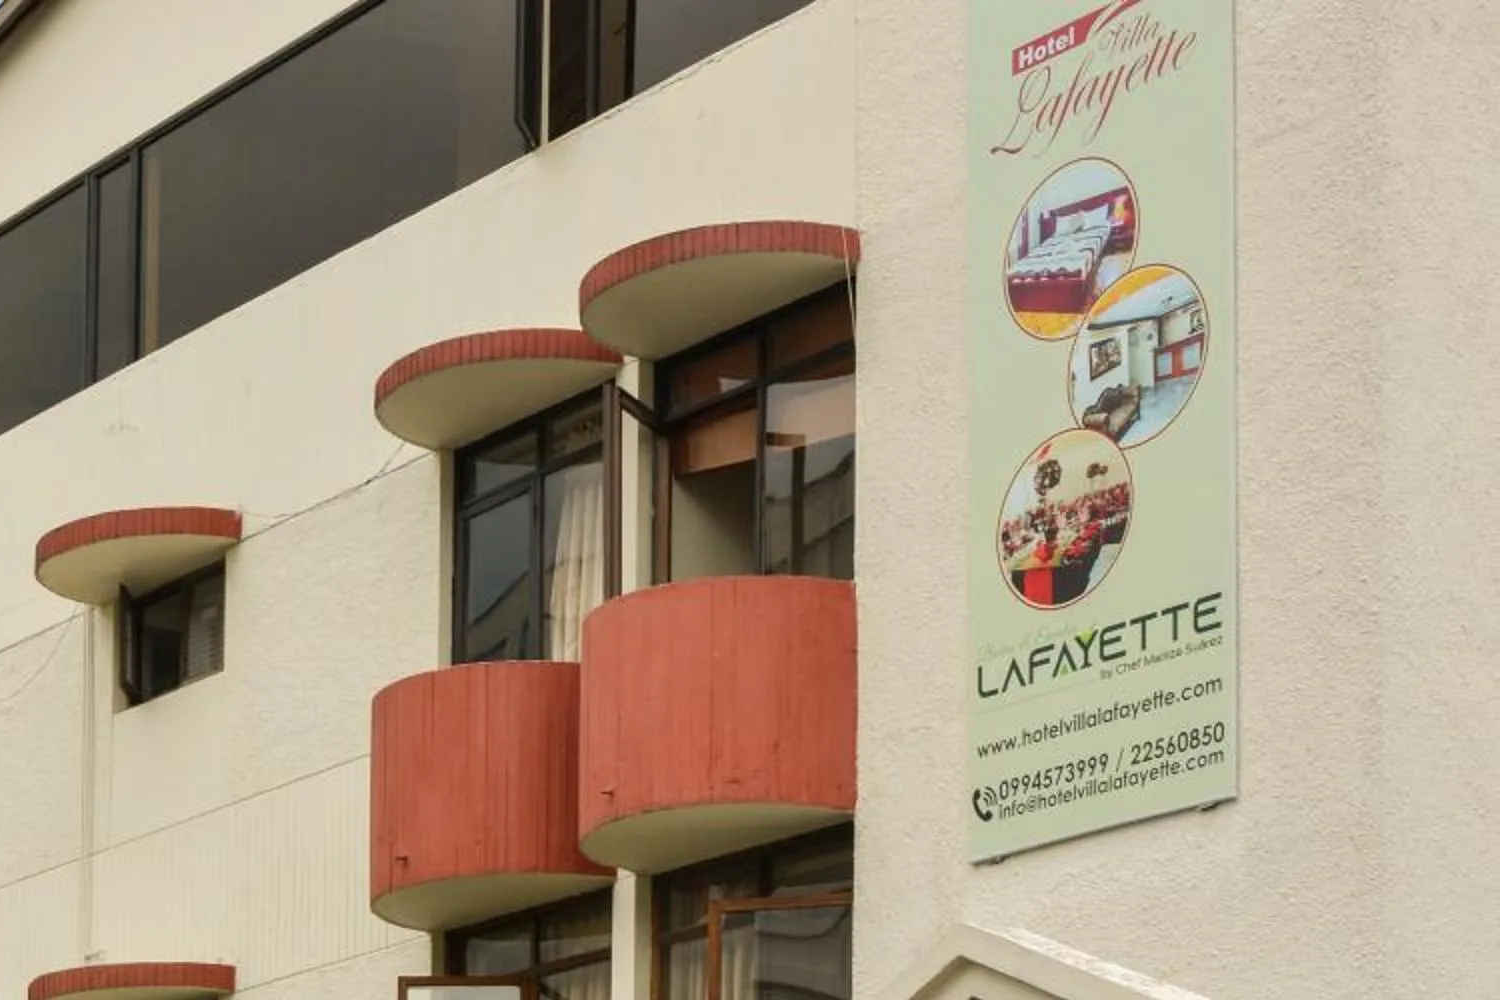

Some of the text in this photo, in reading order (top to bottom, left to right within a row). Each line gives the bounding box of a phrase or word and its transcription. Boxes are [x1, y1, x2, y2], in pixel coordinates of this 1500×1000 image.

[1018, 27, 1076, 69] Hotel
[1100, 14, 1160, 55] Villa
[990, 30, 1197, 158] Lafayette
[977, 591, 1223, 699] LAFAYETTE
[1115, 657, 1142, 675] Chef
[976, 677, 1223, 760] www.hotelvillalafayette.com
[998, 721, 1225, 800] 0994573999 / 22560850
[998, 749, 1225, 820] info@hotelvillalafayette.com
